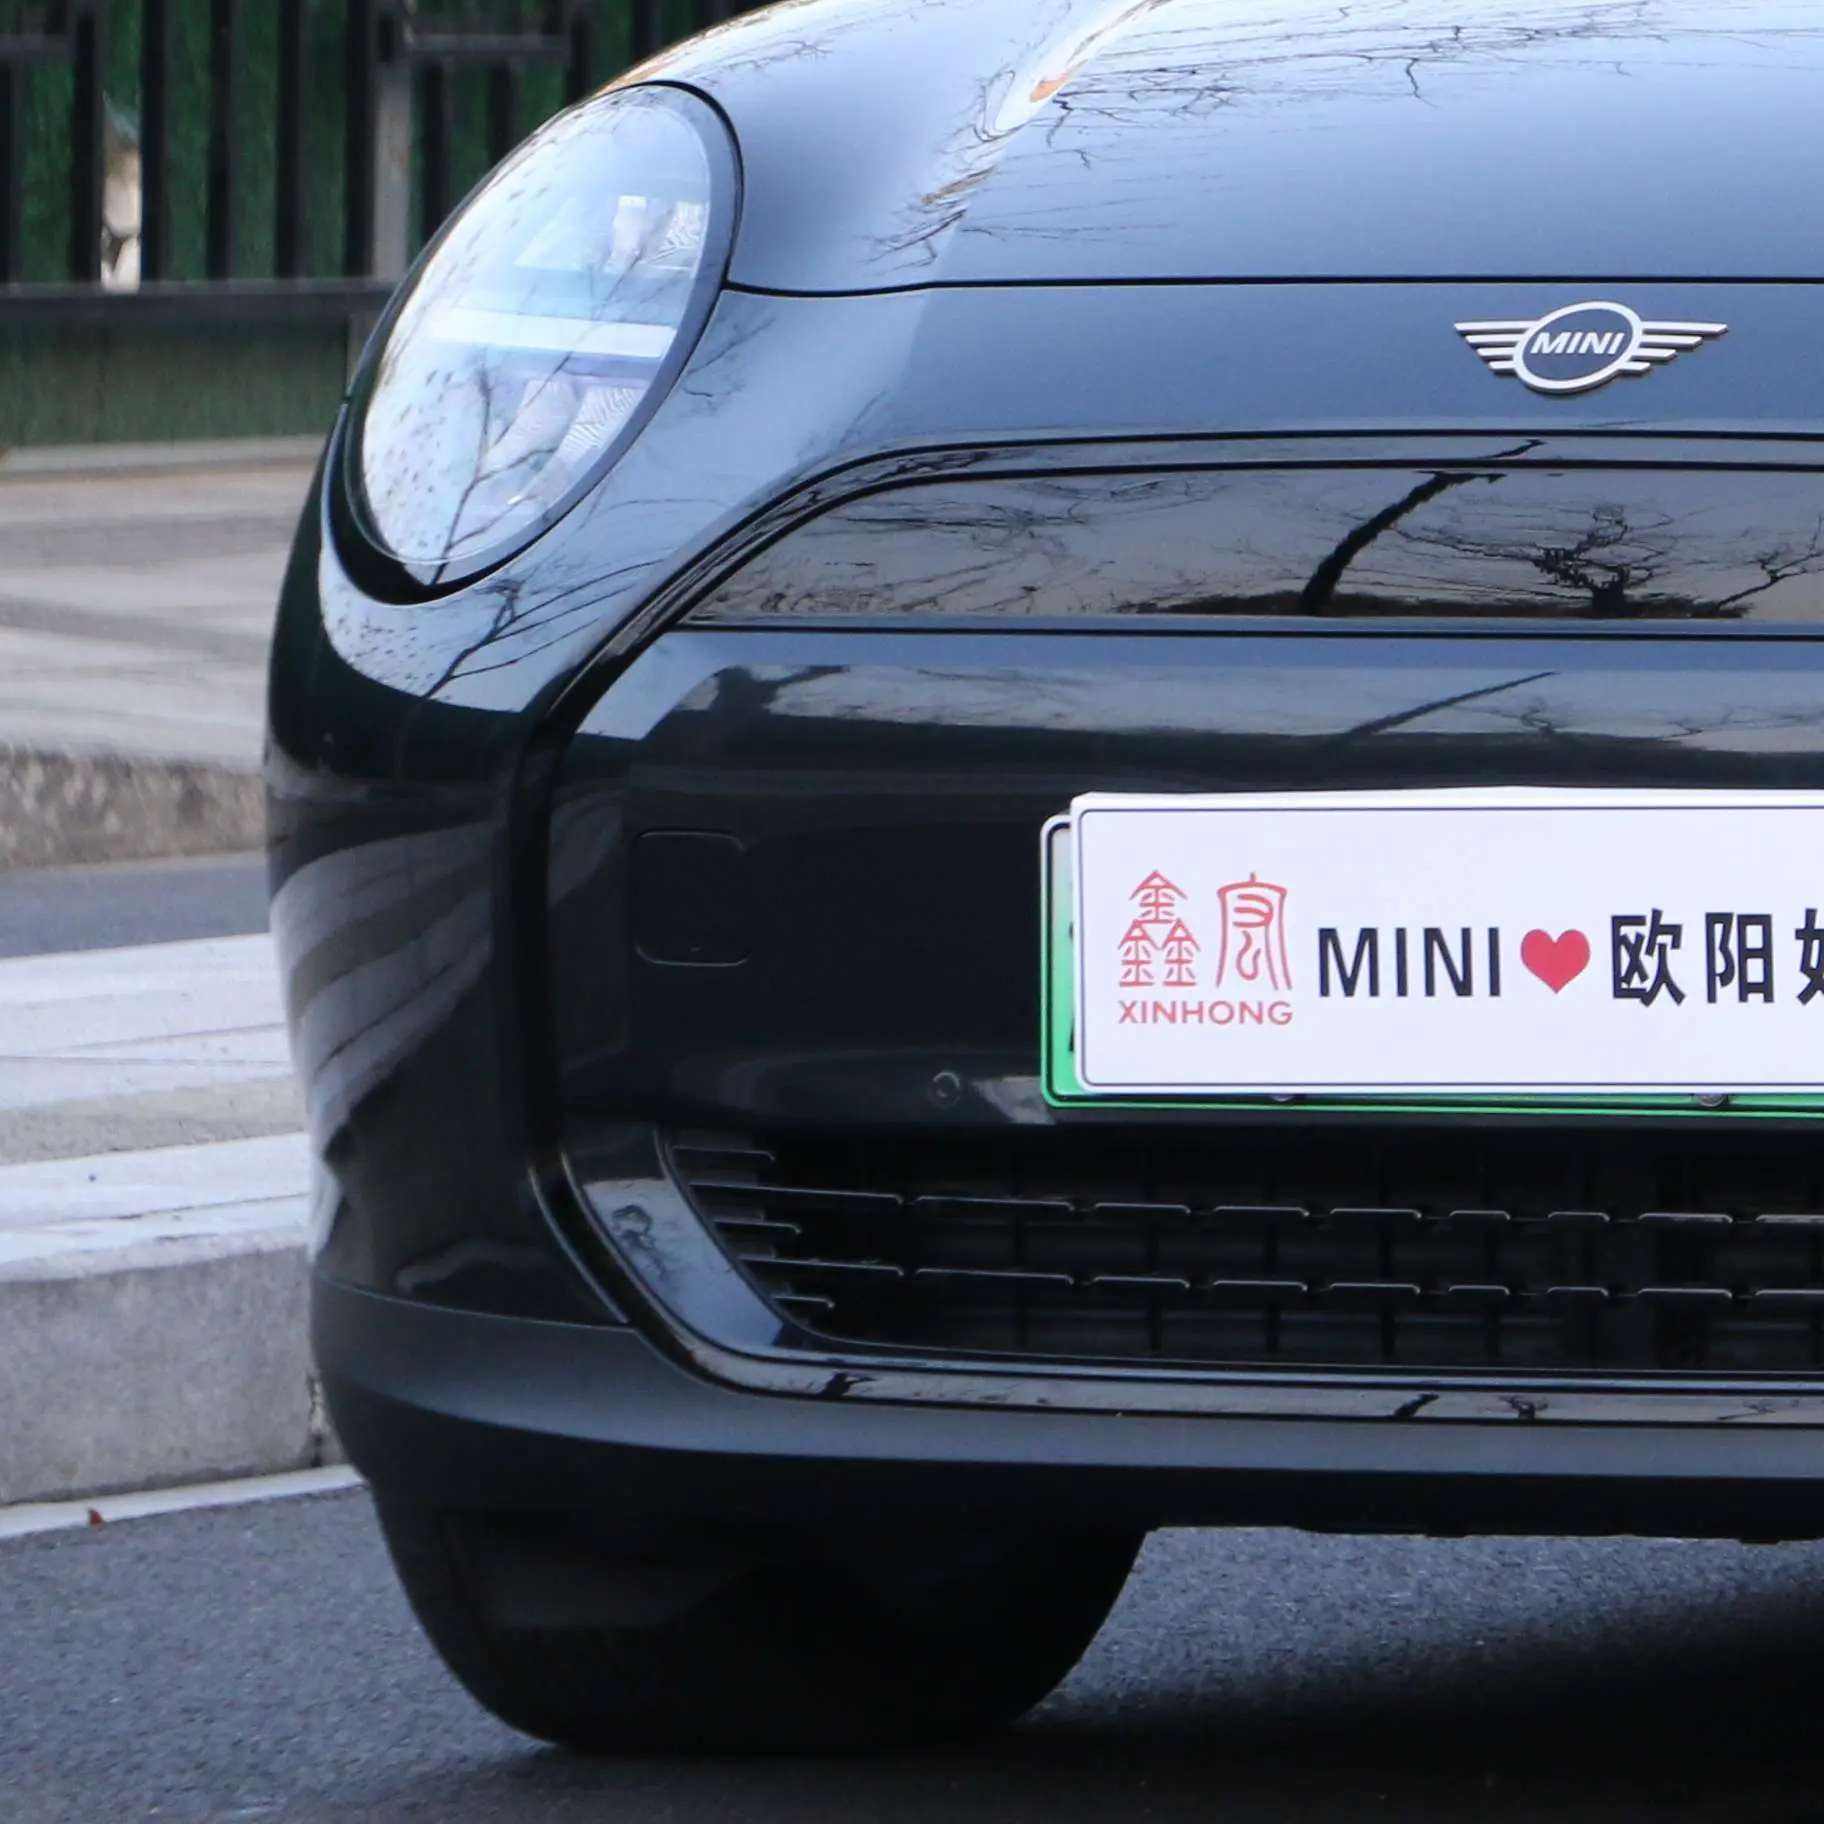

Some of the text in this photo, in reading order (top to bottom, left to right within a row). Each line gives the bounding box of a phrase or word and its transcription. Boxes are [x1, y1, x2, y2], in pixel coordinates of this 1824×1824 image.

[1530, 331, 1625, 355] MINI
[1318, 926, 1501, 998] MINI
[1117, 999, 1293, 1026] XINHONG
